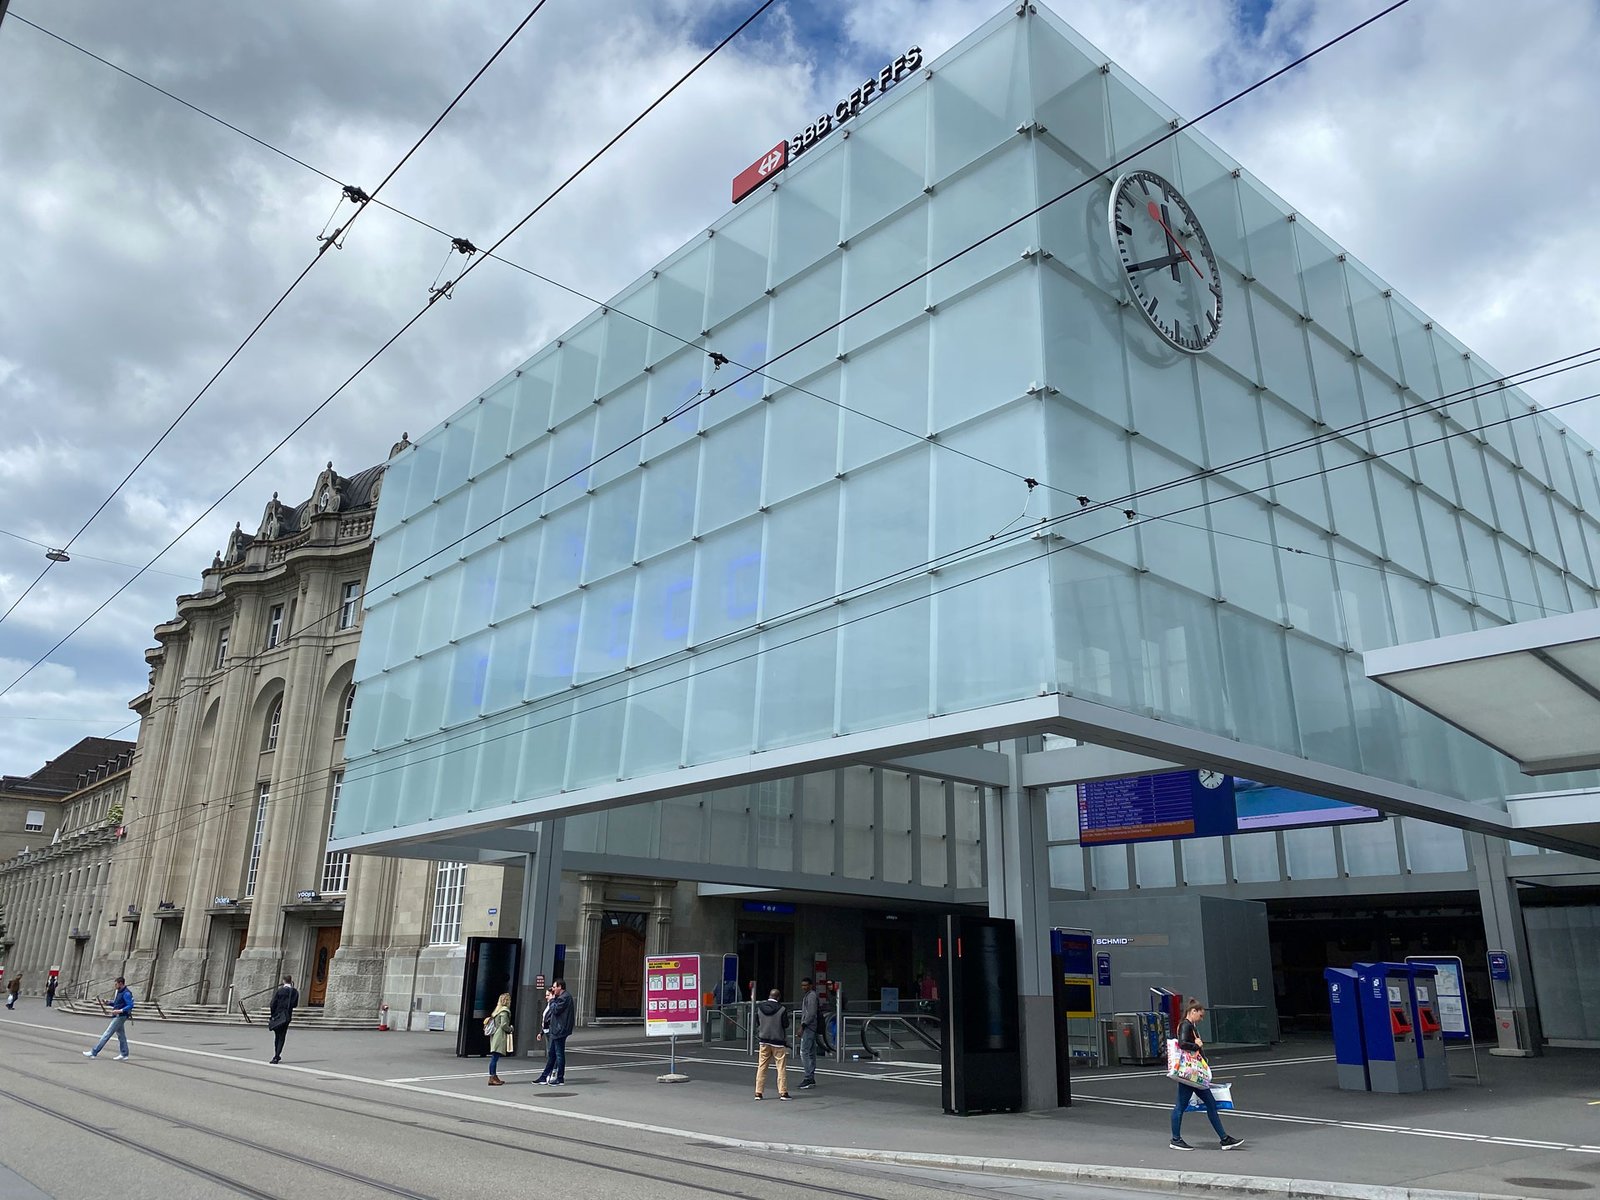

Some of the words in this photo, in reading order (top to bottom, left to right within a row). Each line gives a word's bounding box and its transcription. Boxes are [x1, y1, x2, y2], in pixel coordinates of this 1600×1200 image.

[790, 113, 831, 155] SBB
[834, 78, 876, 123] CFF
[879, 45, 922, 92] FFS
